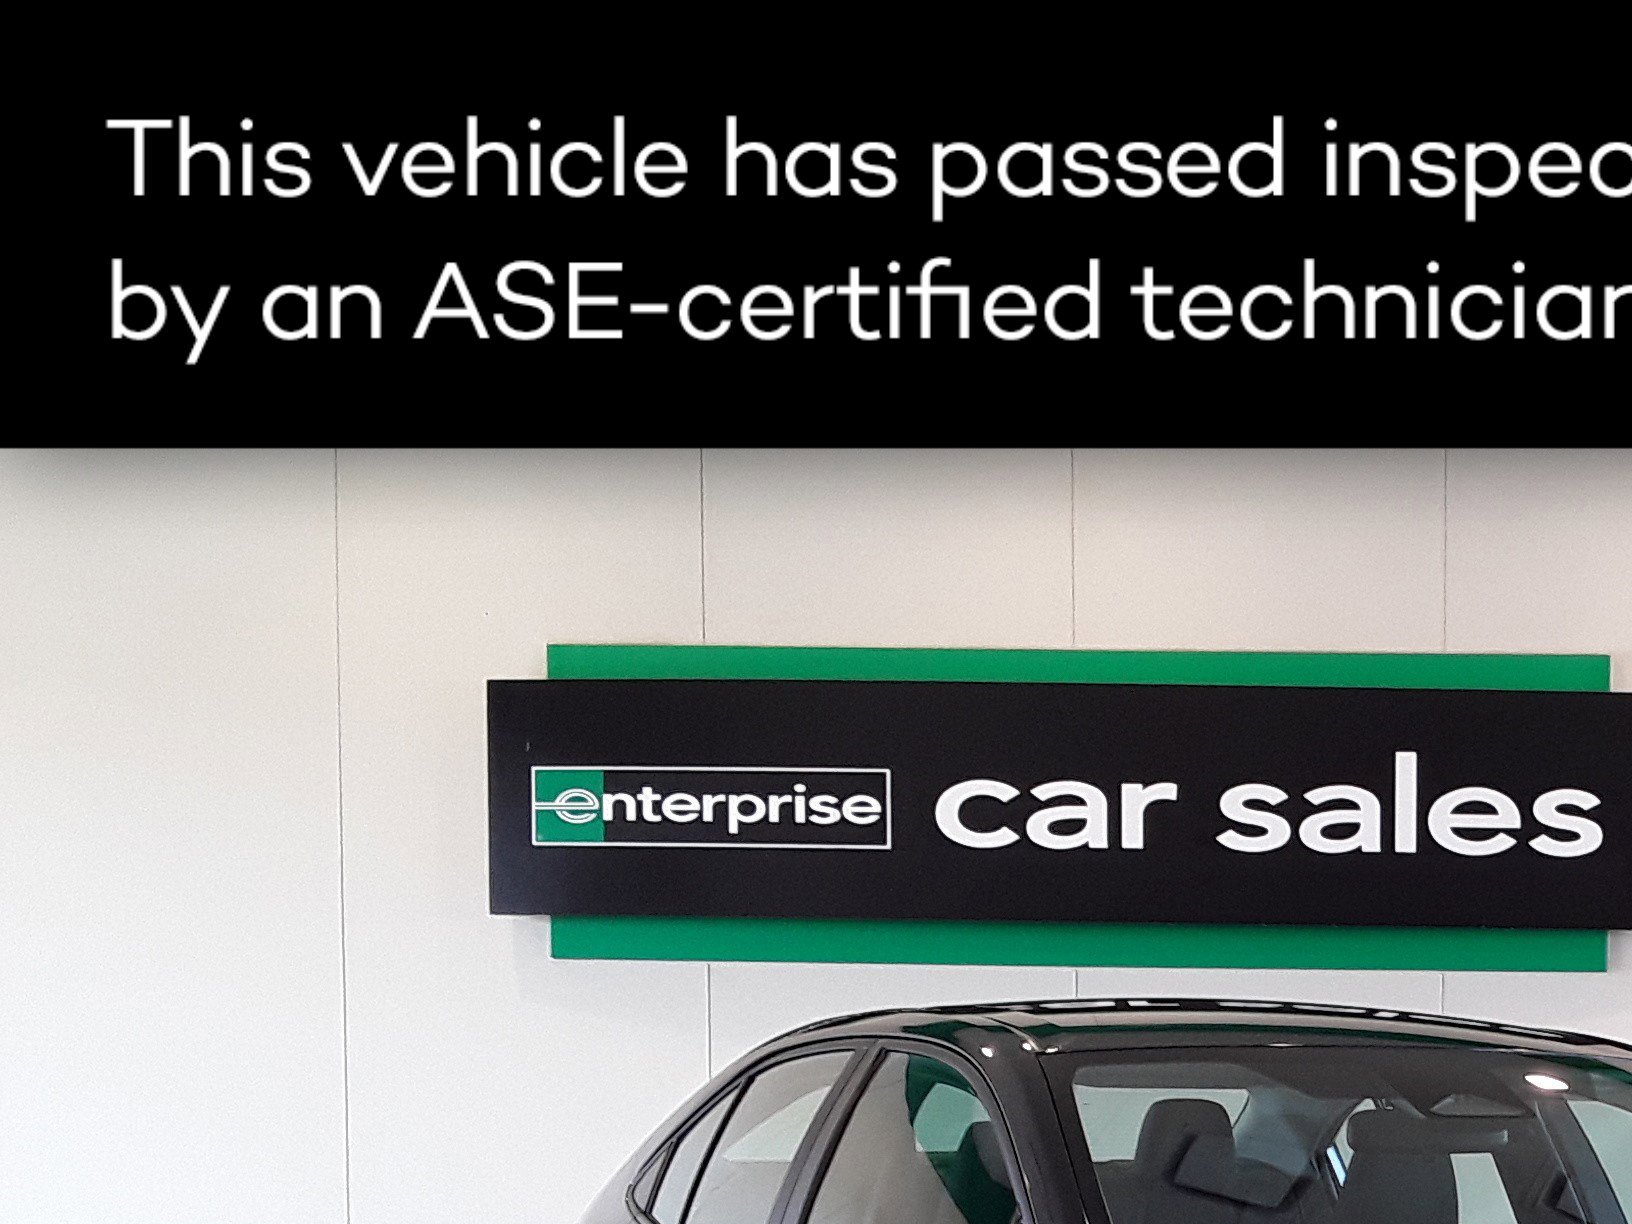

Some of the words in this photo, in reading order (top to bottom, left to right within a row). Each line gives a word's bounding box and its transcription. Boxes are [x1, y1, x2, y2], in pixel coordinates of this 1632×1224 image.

[540, 782, 882, 835] enterprise
[934, 779, 1178, 850] car
[1215, 751, 1604, 858] sales
